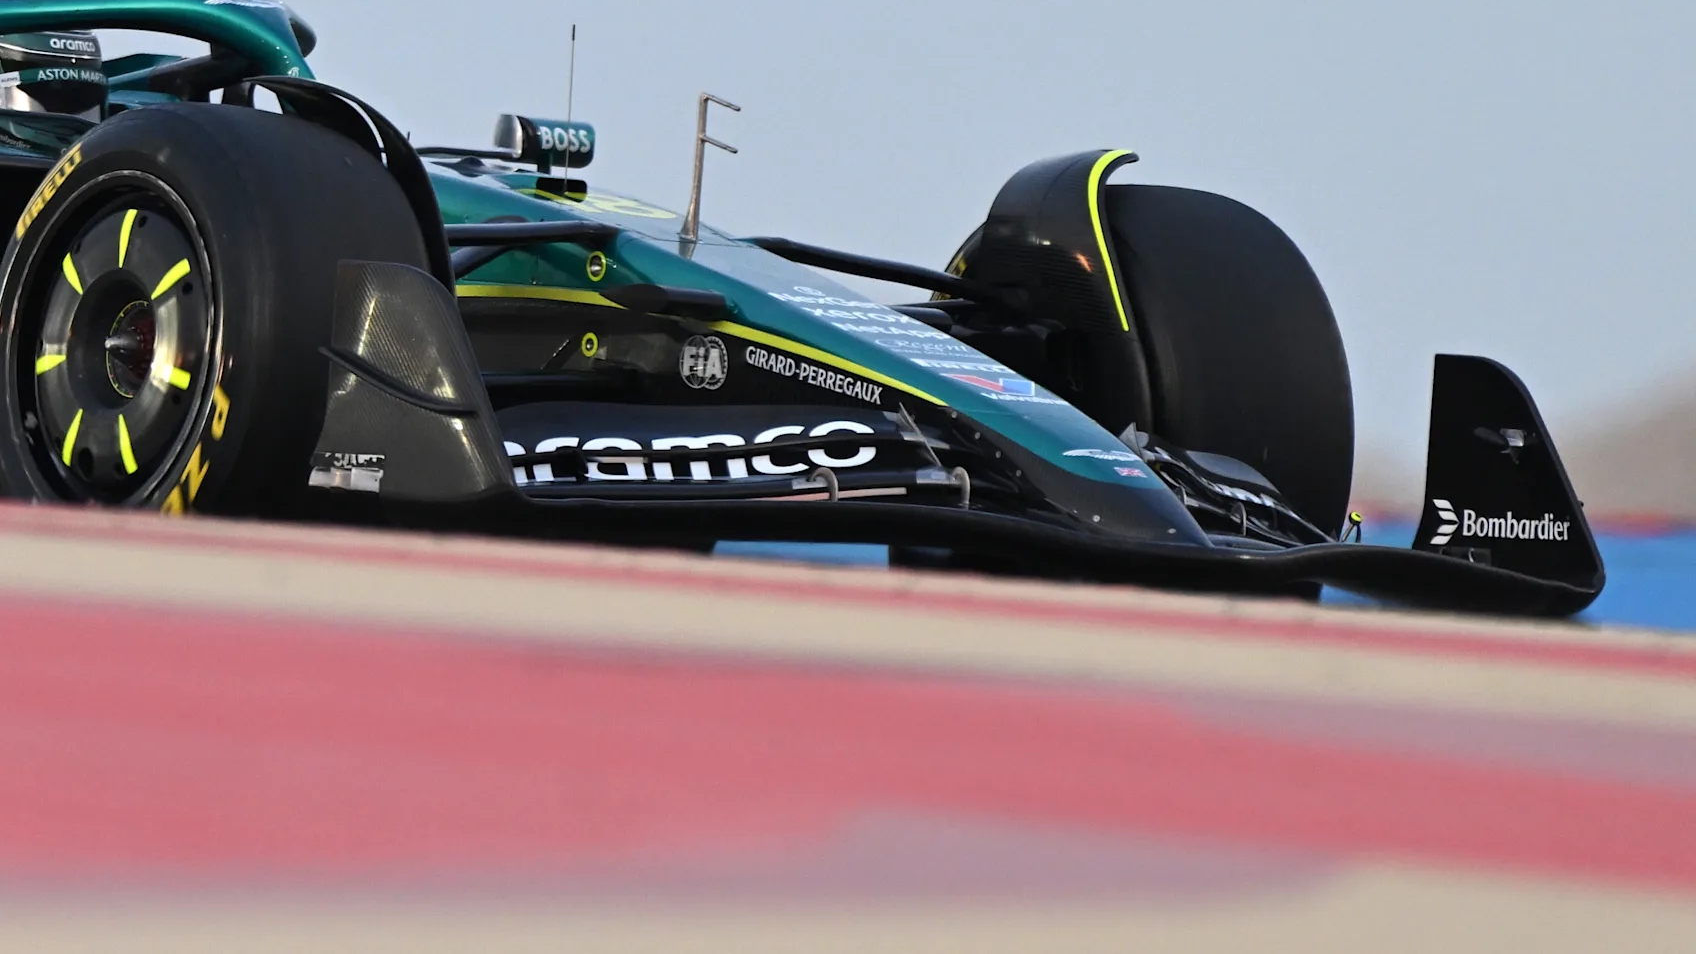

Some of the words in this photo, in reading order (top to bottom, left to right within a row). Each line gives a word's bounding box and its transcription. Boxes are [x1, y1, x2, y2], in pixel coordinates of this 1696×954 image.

[37, 68, 79, 82] ASTON
[539, 126, 592, 153] BOSS
[15, 142, 83, 241] PIRELLI
[745, 345, 884, 405] GIRARD-PERREGAUX
[1462, 509, 1571, 542] Bombardier
